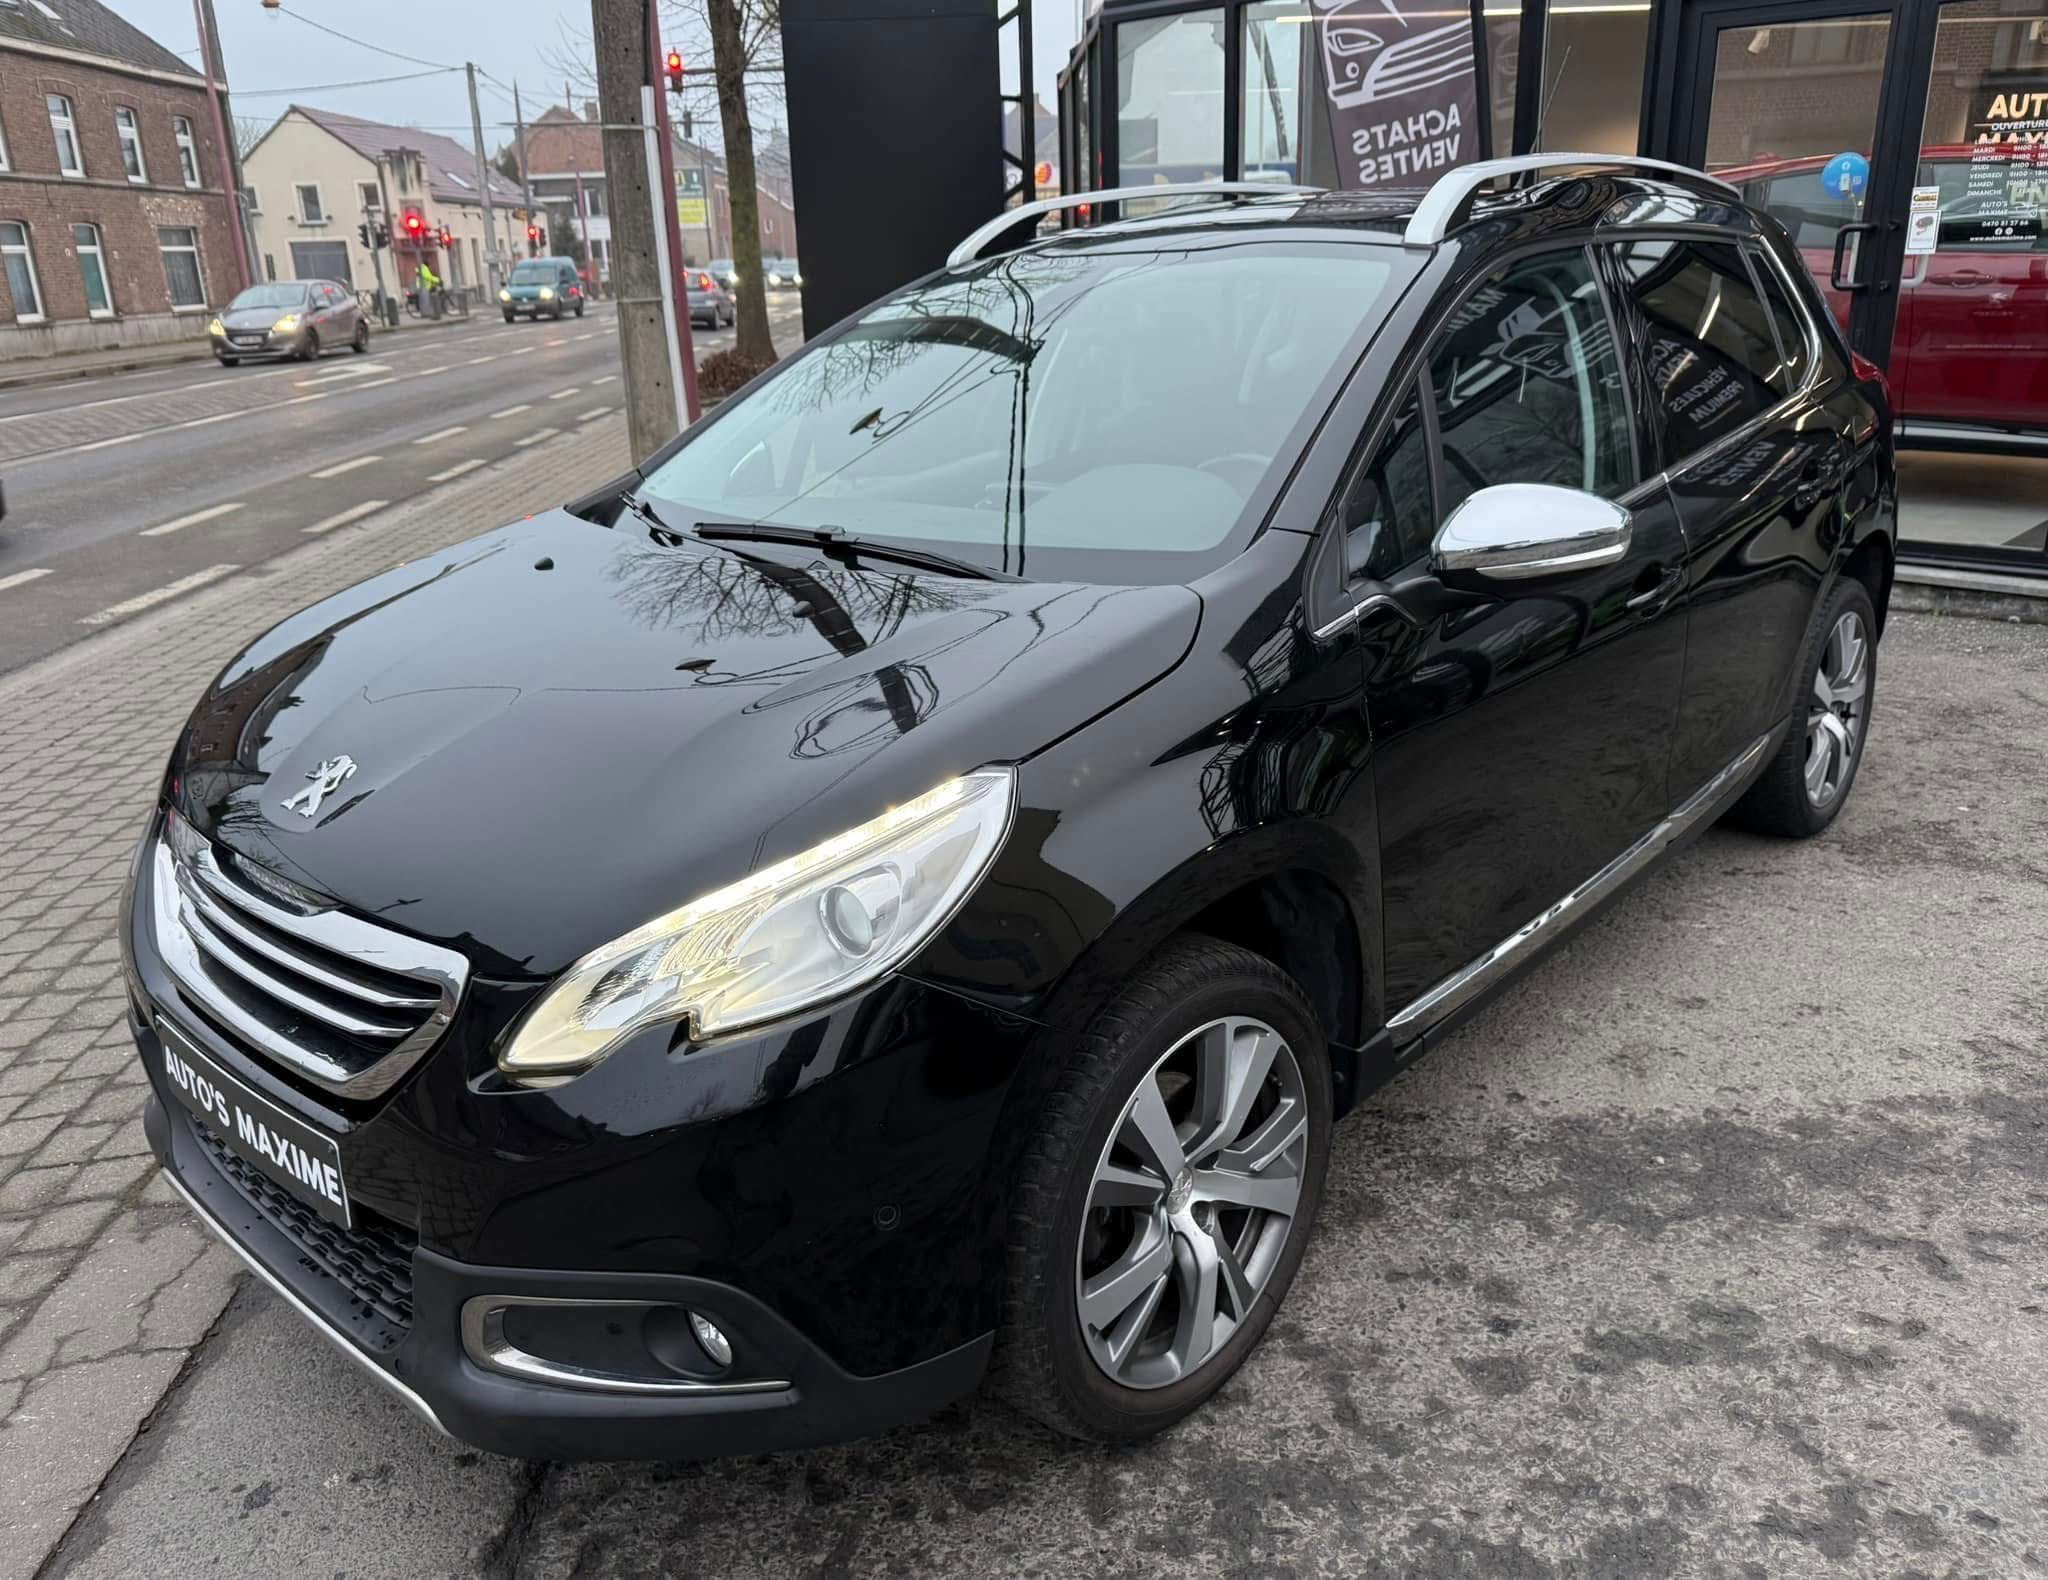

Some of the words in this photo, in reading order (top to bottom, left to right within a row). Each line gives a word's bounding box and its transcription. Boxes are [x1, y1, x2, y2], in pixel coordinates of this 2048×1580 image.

[1986, 93, 2048, 119] AUT
[1968, 180, 1994, 188] SAMEDI
[1967, 189, 2003, 197] DIMANCHE
[165, 1045, 230, 1127] AUTO'S
[235, 1105, 342, 1206] MAXIME
